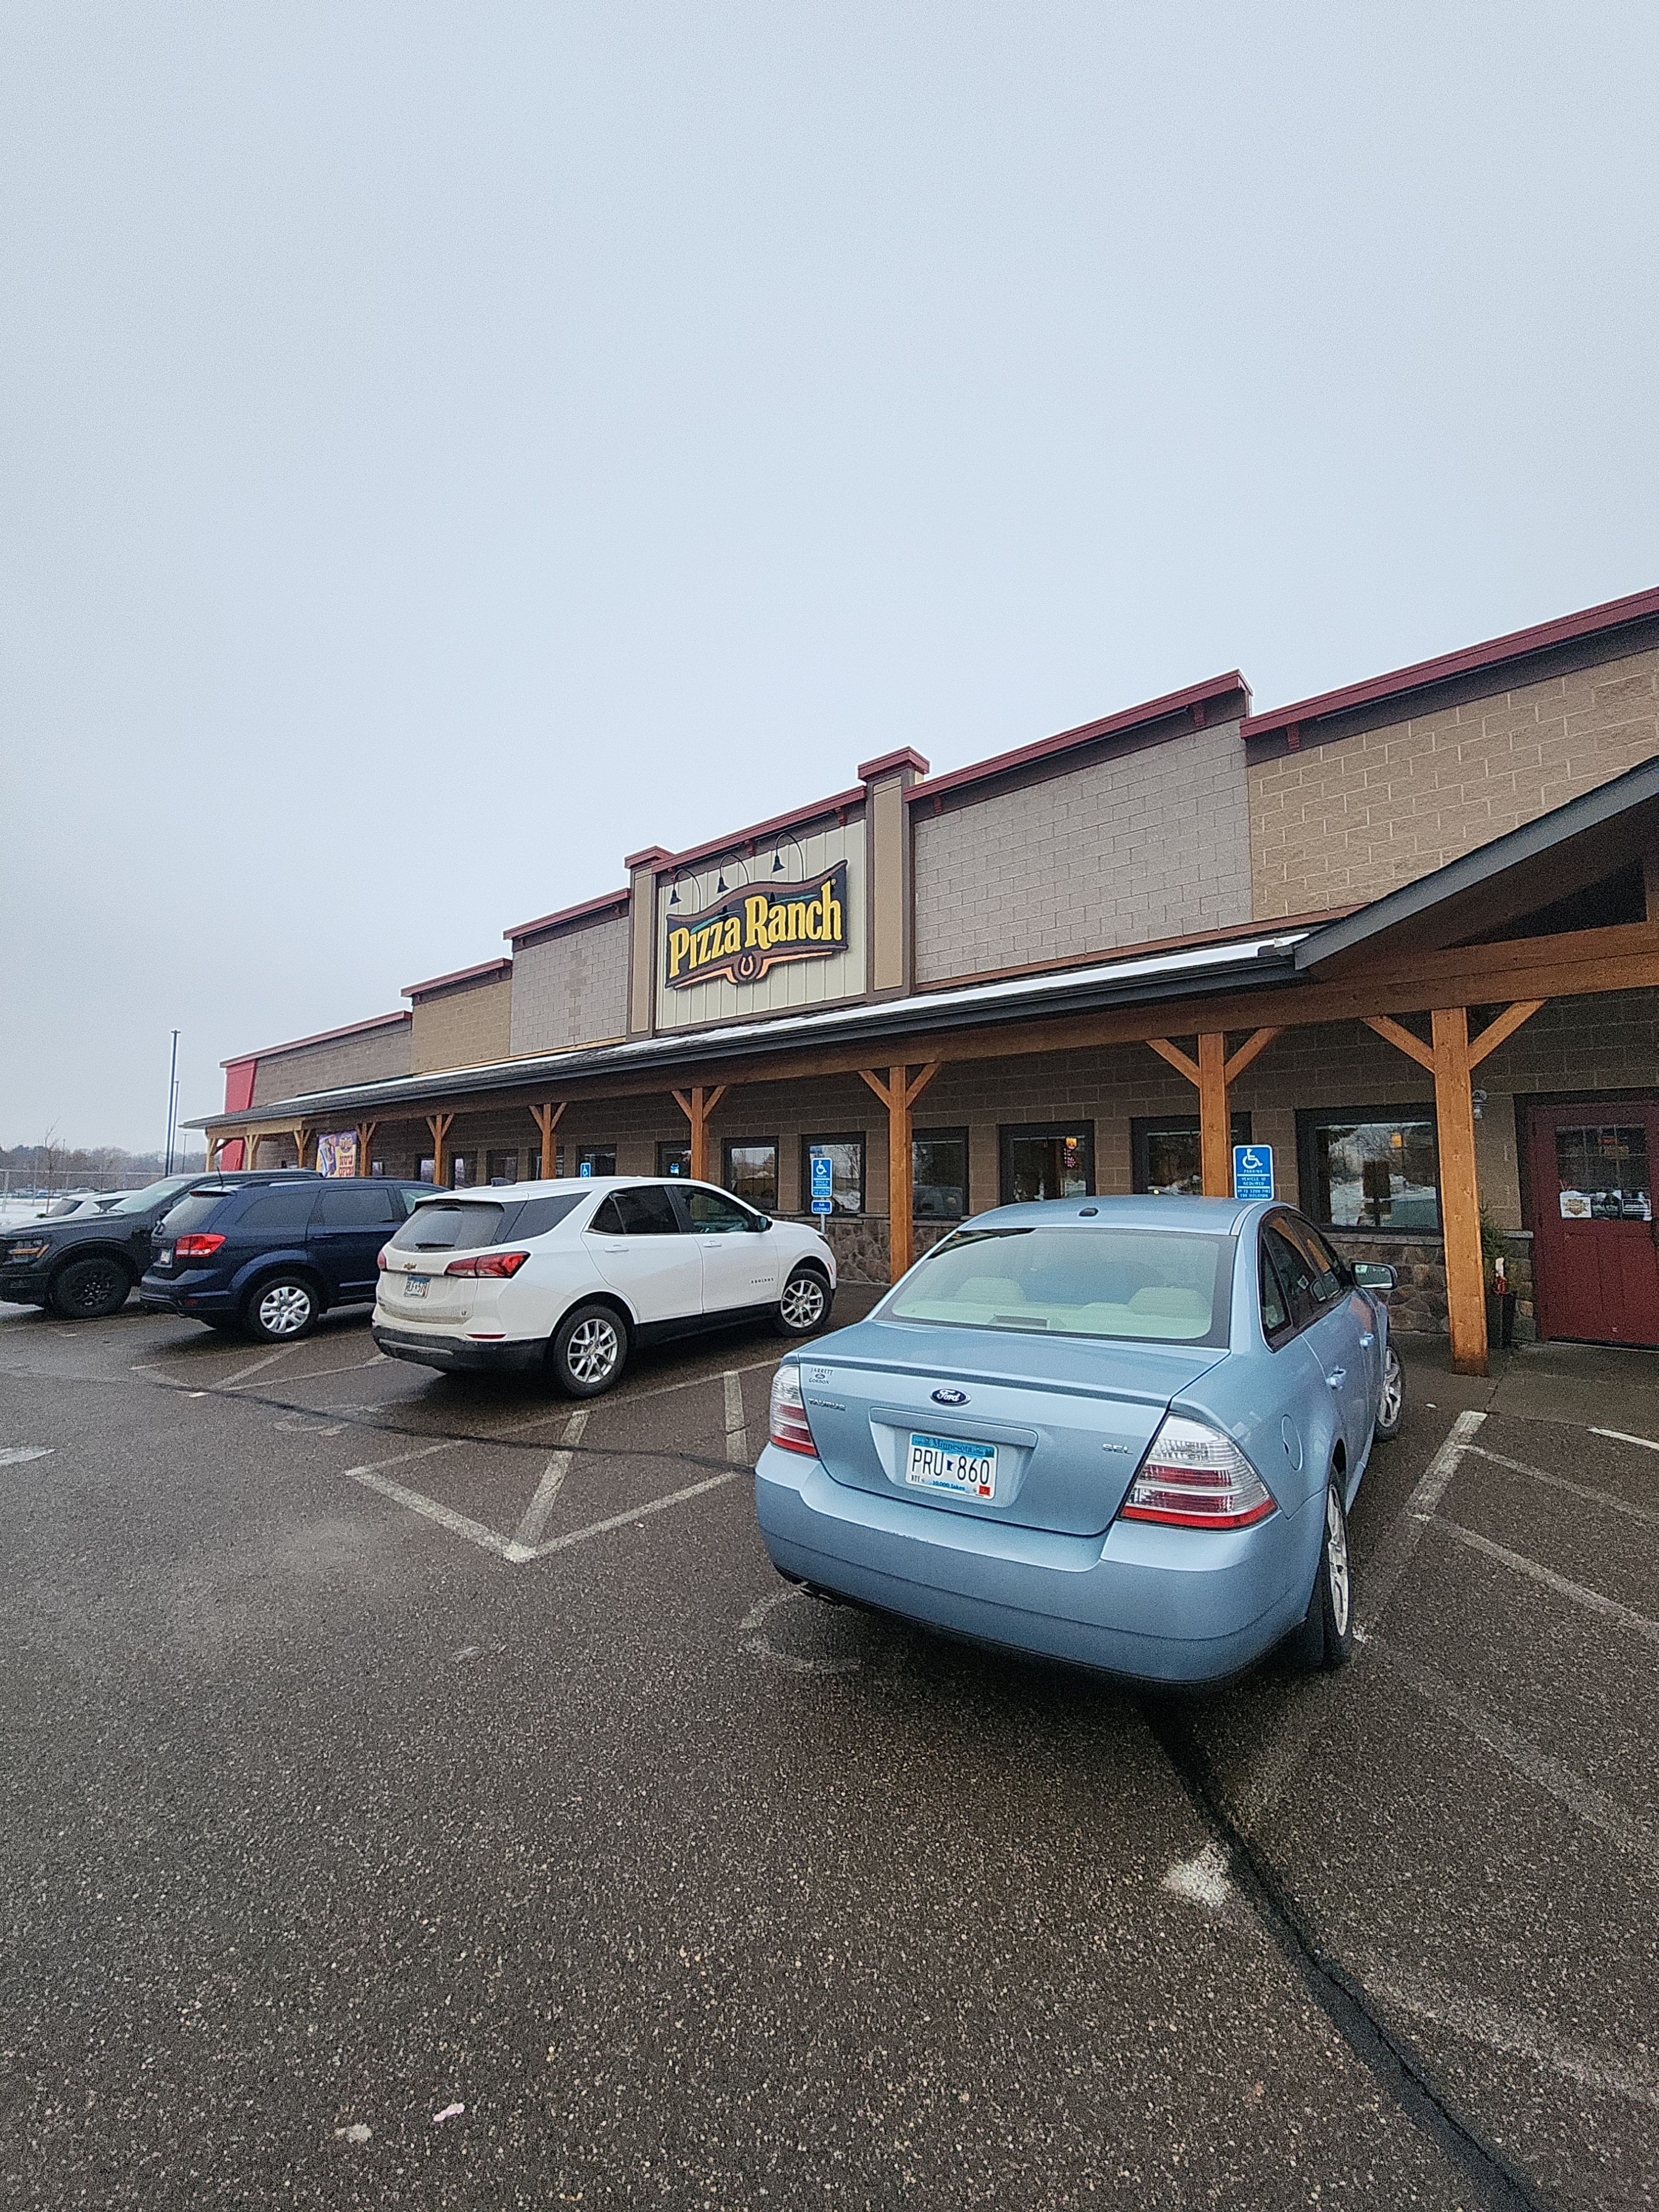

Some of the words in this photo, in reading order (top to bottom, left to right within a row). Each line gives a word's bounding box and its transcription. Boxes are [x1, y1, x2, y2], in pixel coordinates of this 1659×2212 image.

[669, 917, 742, 979] Pizza
[744, 881, 843, 950] Ranch
[811, 1367, 833, 1376] JARRETT
[936, 1389, 961, 1402] Ford
[808, 1398, 847, 1411] TAURUS
[933, 1438, 972, 1453] Minnesota
[1102, 1443, 1133, 1454] SEL
[912, 1448, 944, 1476] PRU
[957, 1455, 990, 1485] 860
